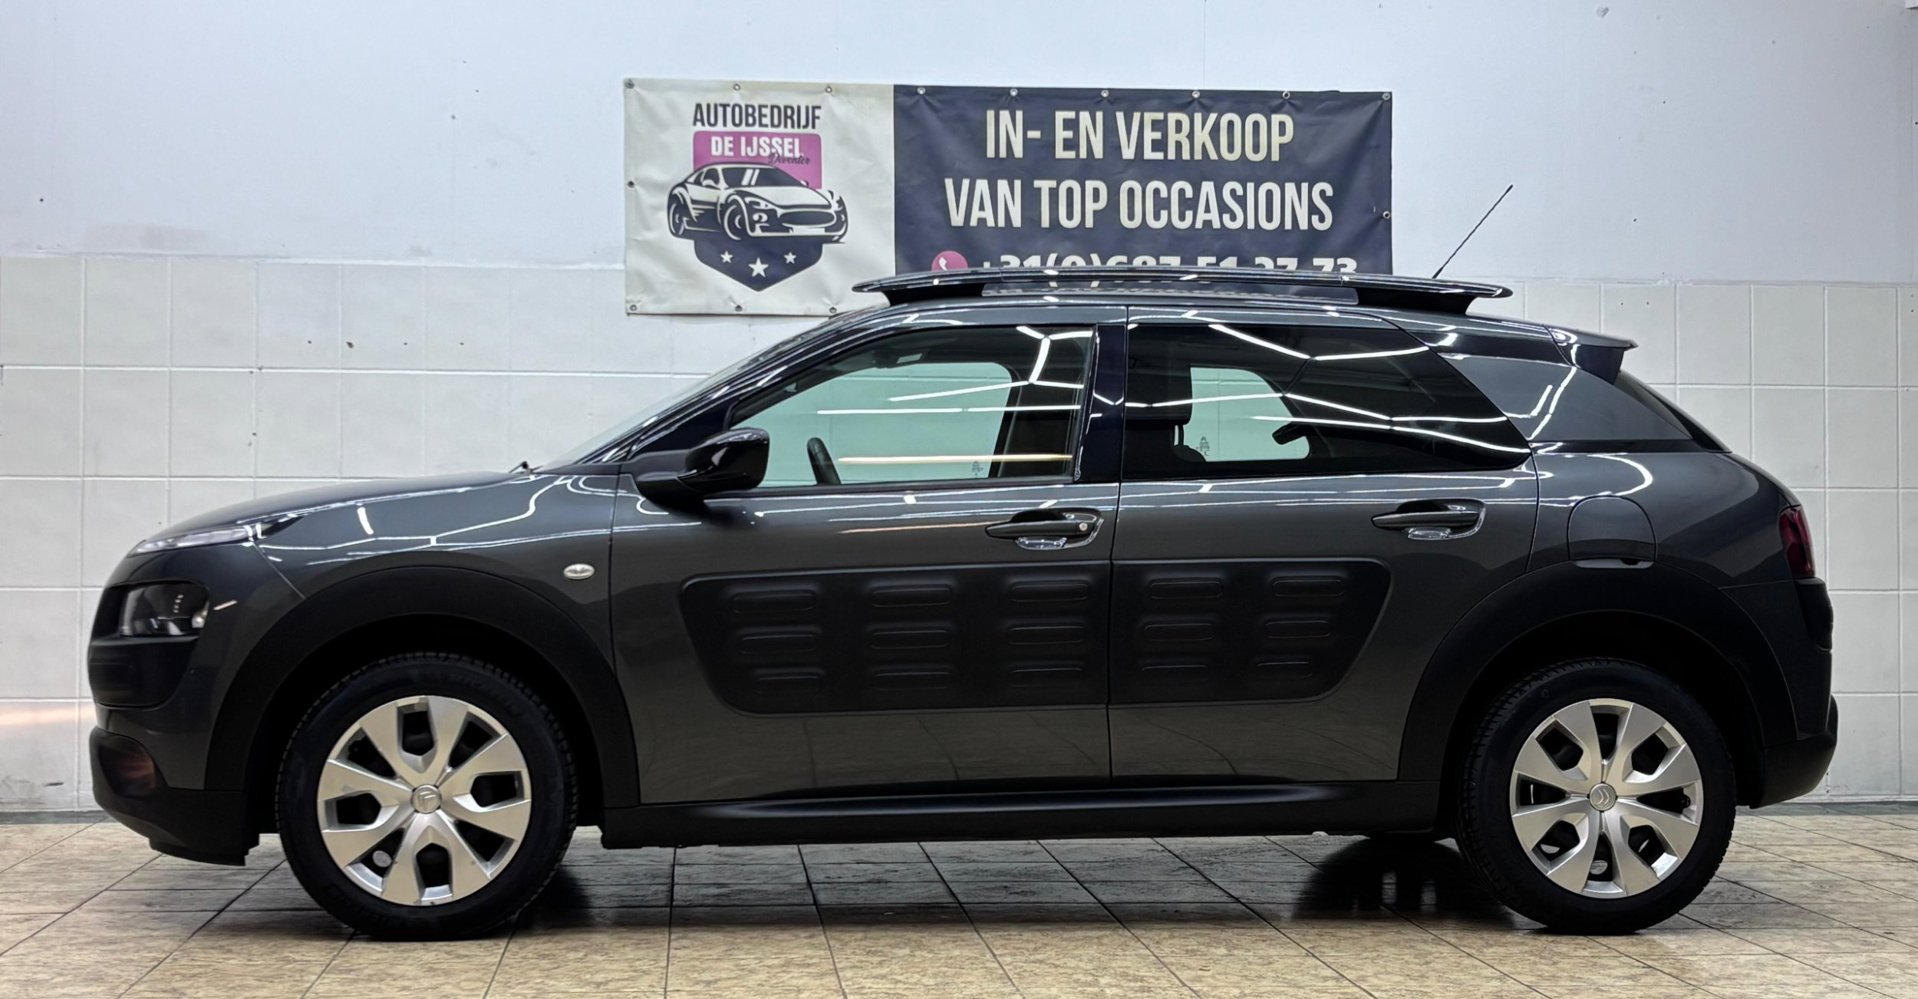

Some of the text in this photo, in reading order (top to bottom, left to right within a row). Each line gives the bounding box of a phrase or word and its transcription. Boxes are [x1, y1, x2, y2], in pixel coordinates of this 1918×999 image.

[692, 103, 821, 129] AUTOBEDRIJF
[711, 136, 803, 158] DE IJSSEL
[986, 110, 1293, 161] IN- EN VERKOOP
[944, 178, 1333, 230] VAN TOP OCCASIONS
